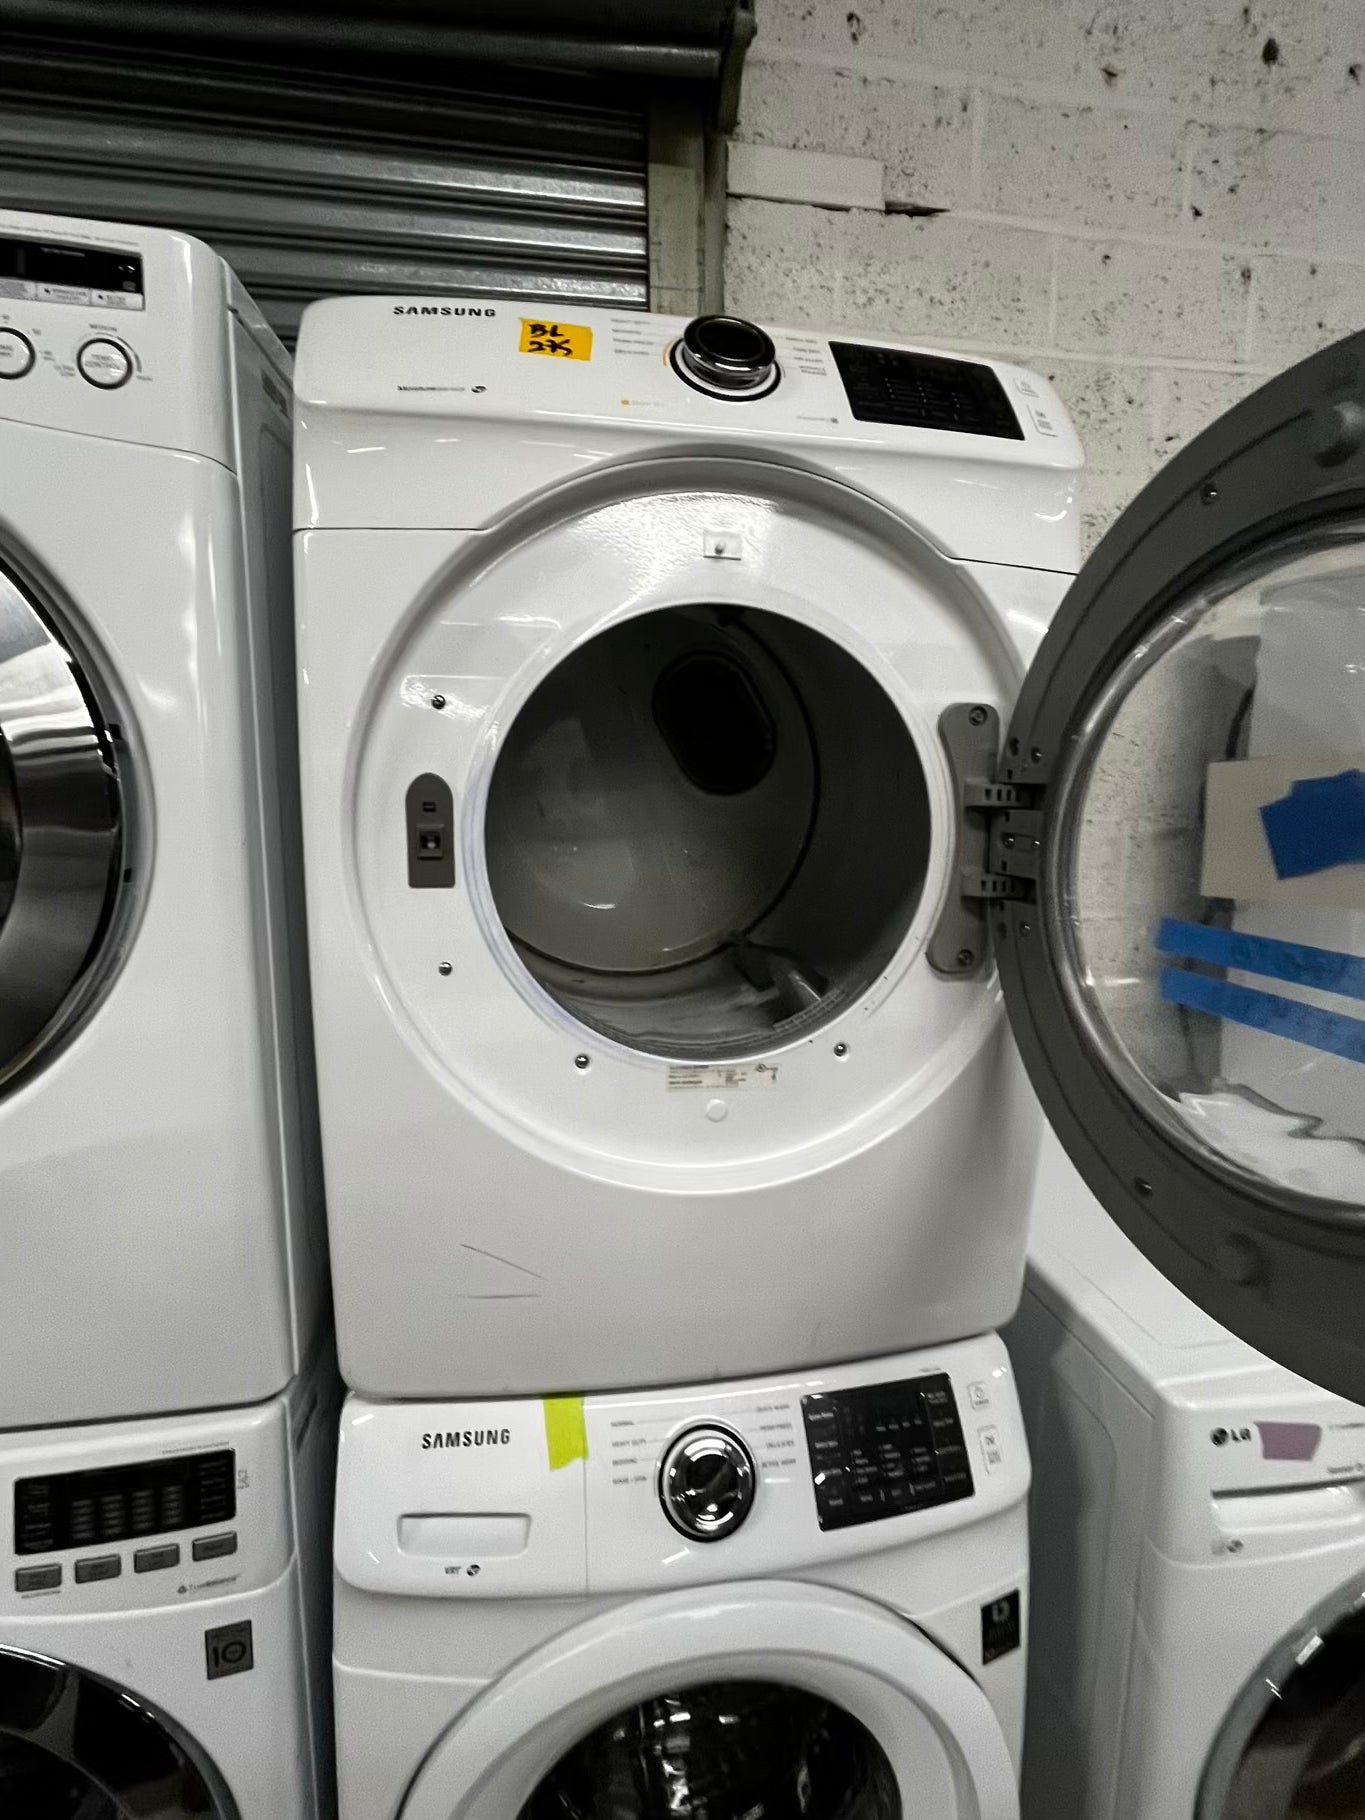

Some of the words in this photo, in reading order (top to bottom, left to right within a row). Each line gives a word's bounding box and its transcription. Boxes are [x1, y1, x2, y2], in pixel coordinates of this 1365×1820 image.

[393, 306, 497, 317] SAMSUNG
[528, 323, 565, 338] BL
[422, 1428, 510, 1449] SAMSUNG
